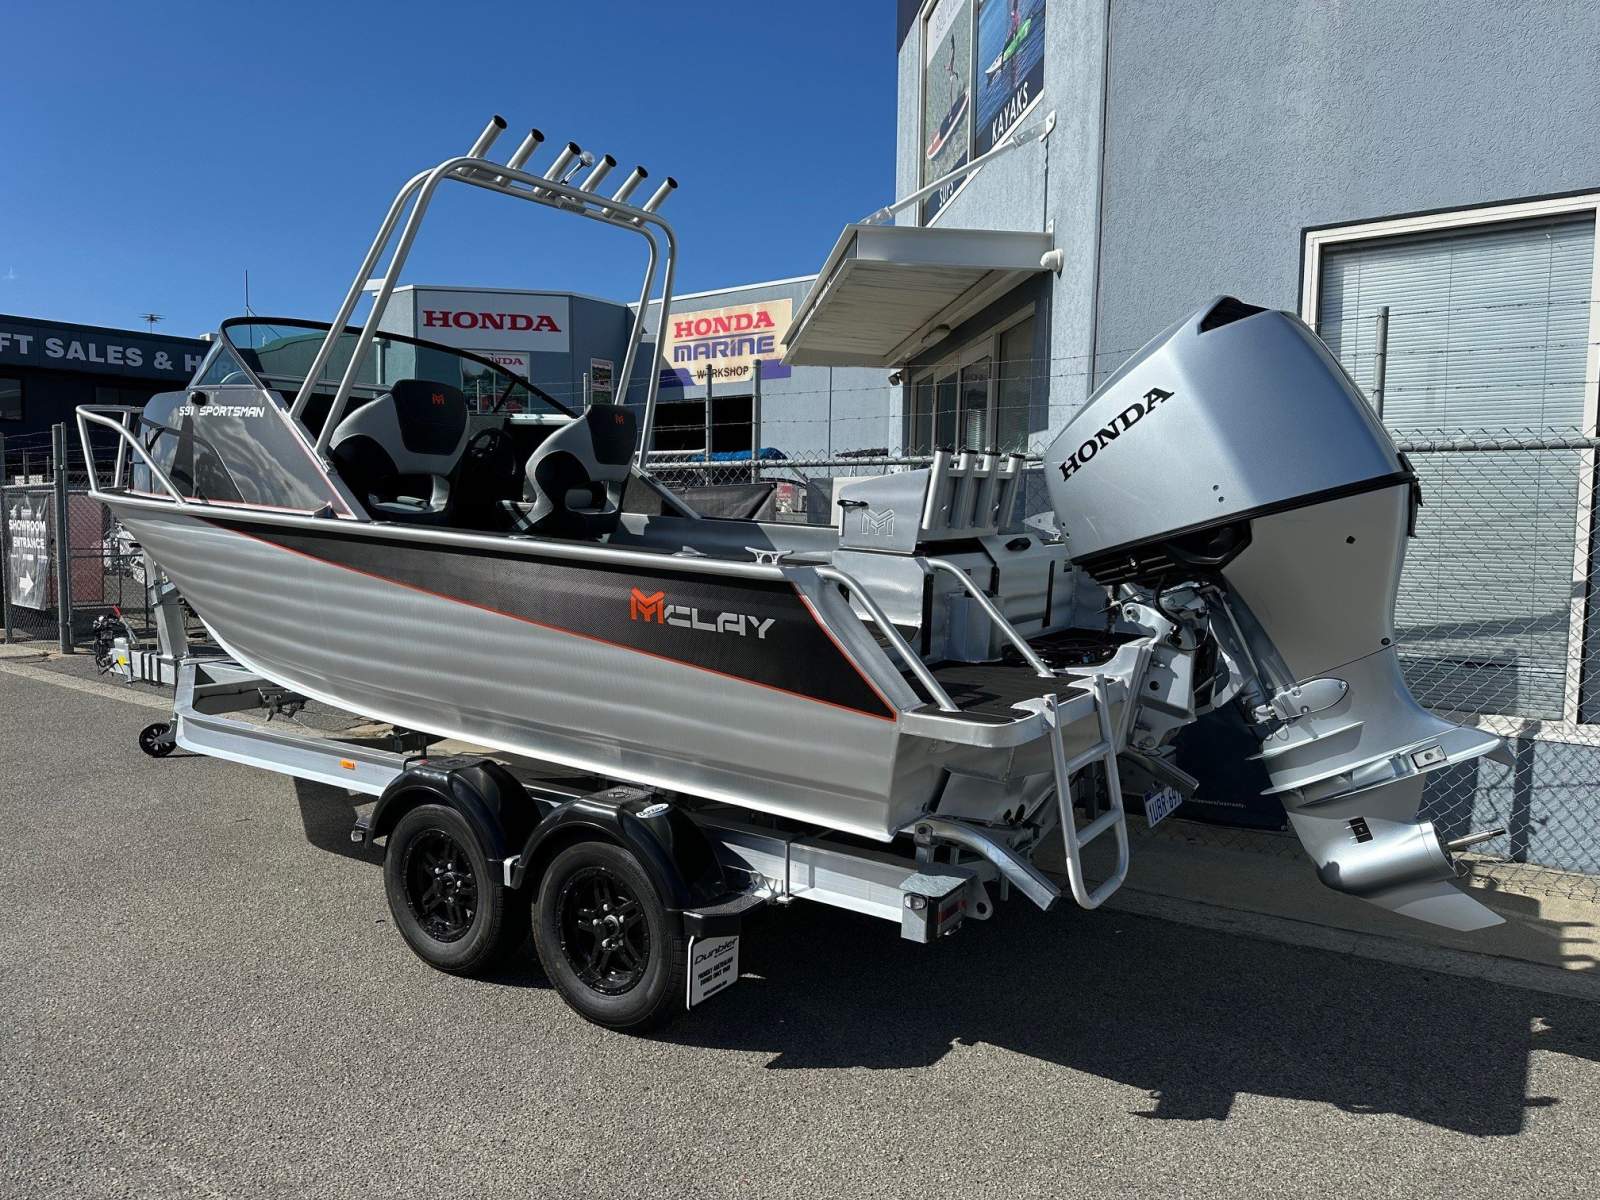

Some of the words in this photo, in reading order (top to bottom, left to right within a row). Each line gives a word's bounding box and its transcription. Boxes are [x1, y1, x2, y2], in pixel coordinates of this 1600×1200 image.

[992, 82, 1029, 145] KAYAKS
[422, 310, 562, 333] HONDA
[673, 310, 776, 339] HONDA
[45, 337, 144, 368] SALES
[153, 351, 174, 371] &
[673, 335, 776, 363] MARINE
[696, 365, 750, 380] WRKSHOP
[198, 405, 266, 418] SPORTSMAN
[1058, 387, 1176, 482] HONDA
[8, 519, 46, 533] SHOWROOM
[12, 536, 46, 550] ENTRANCE
[694, 937, 738, 965] Dunbier
